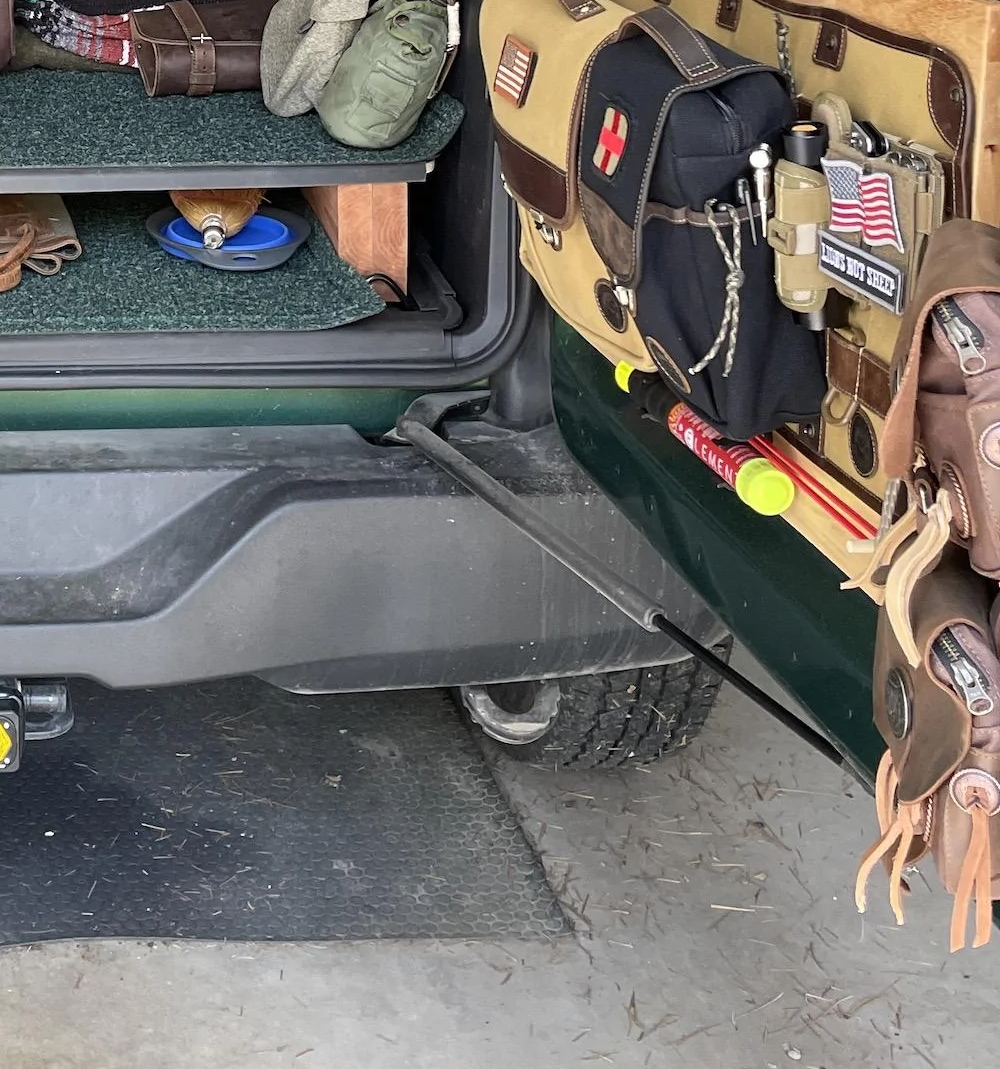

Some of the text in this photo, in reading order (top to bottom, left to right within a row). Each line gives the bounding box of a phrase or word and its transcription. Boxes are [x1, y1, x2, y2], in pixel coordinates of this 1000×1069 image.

[821, 242, 896, 297] LIONS NOT SHEEP
[684, 428, 738, 485] ELEMEN
